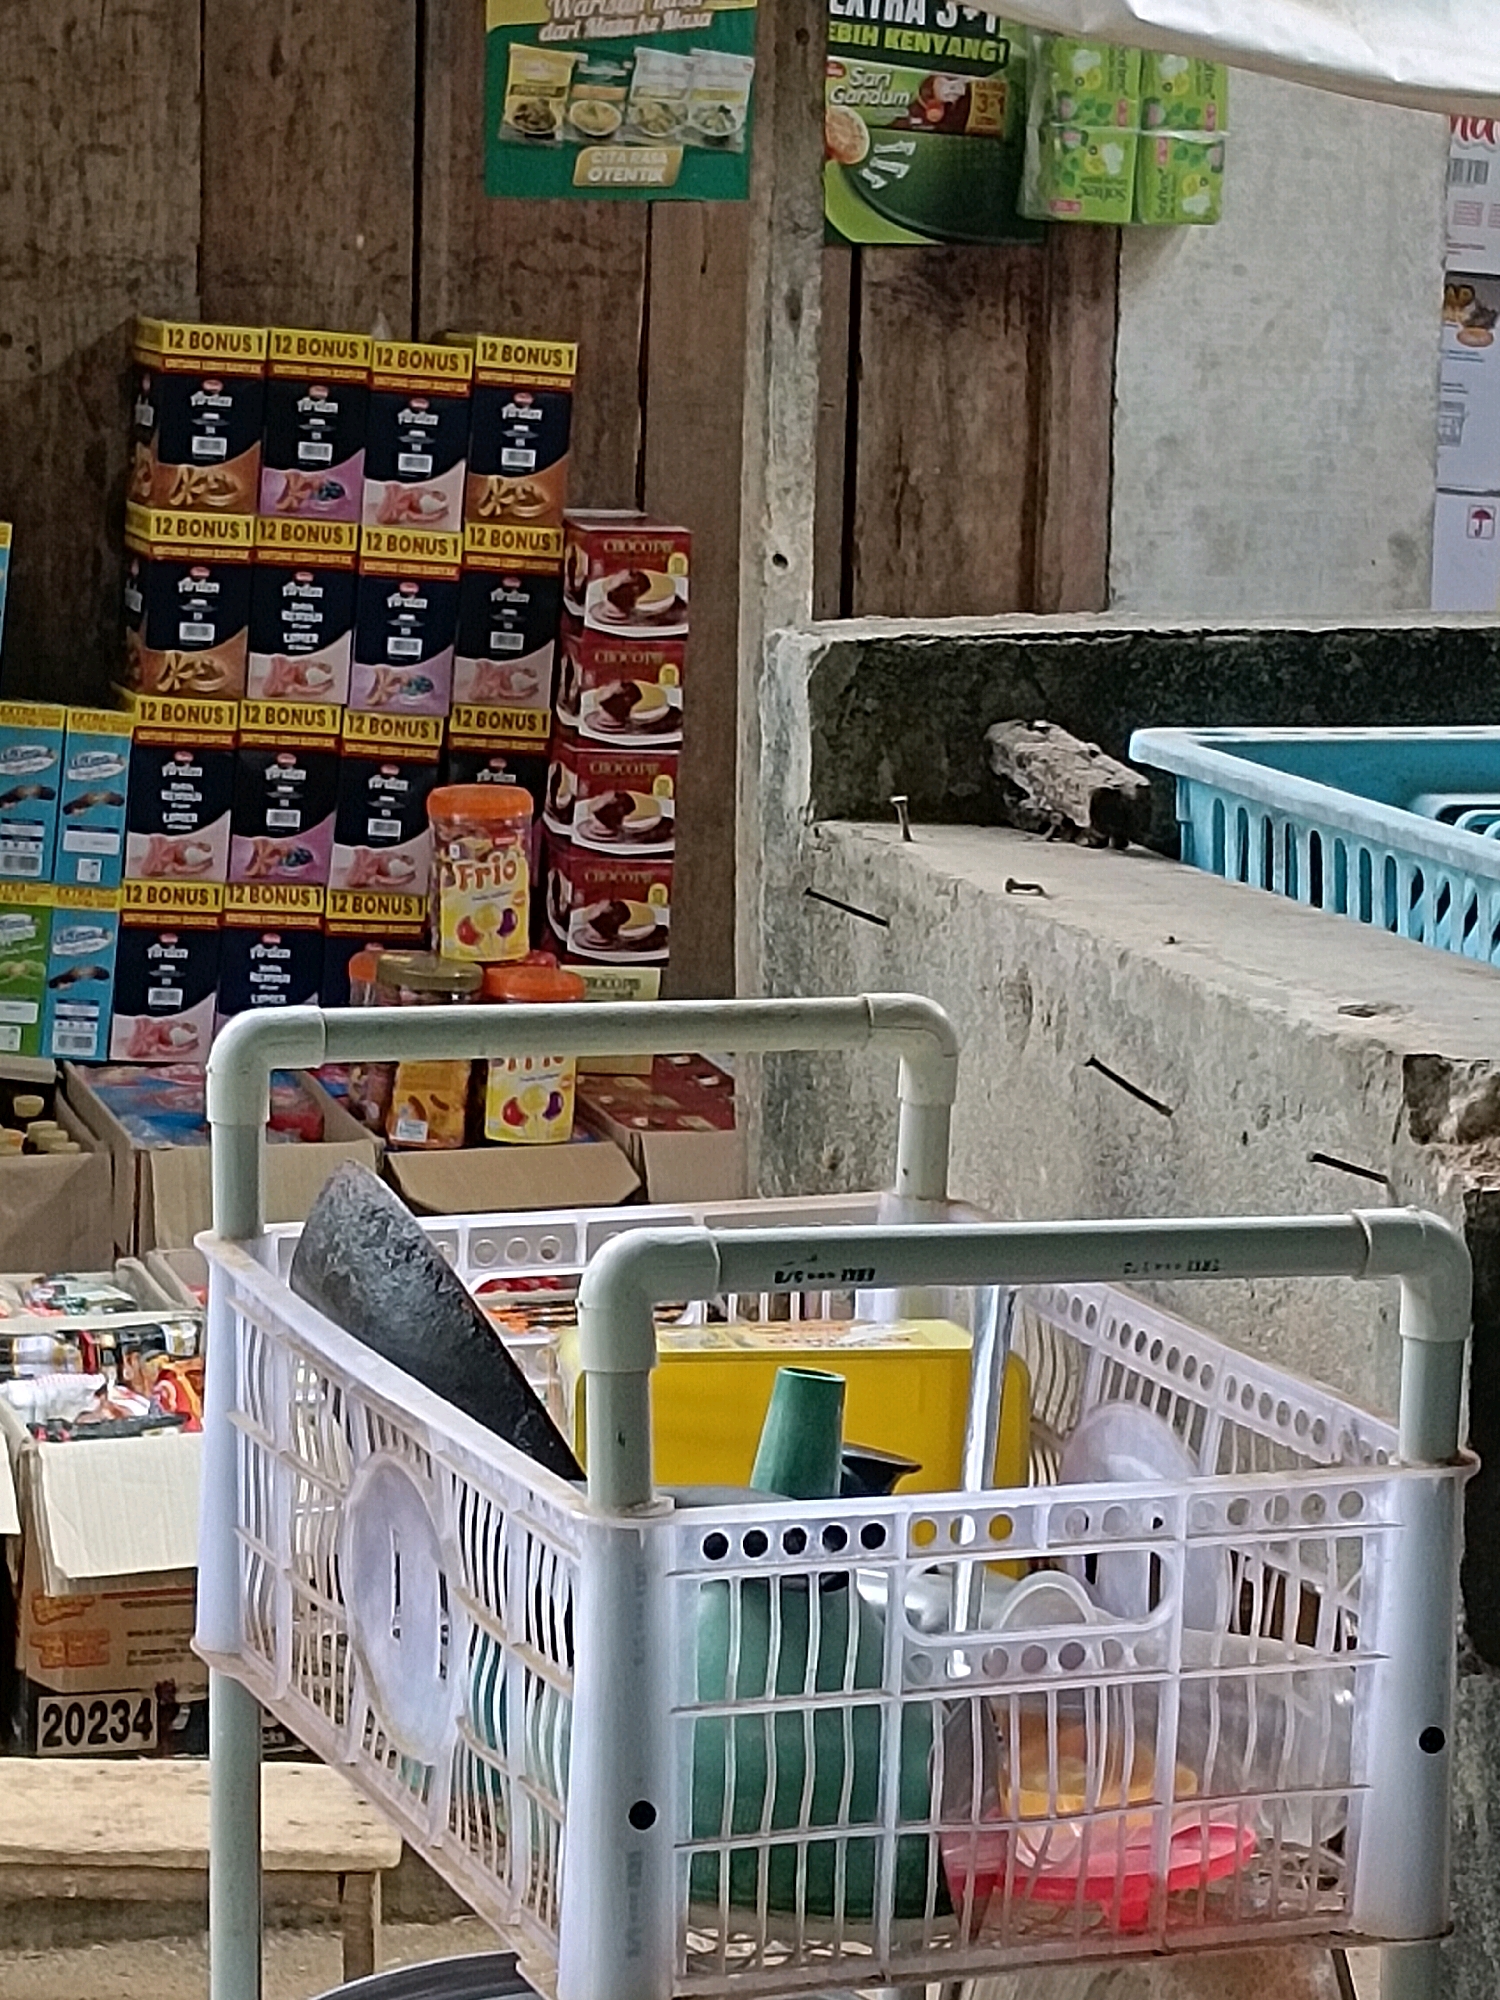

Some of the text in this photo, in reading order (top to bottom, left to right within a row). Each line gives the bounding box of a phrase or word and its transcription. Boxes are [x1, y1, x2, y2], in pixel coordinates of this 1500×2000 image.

[884, 27, 1006, 64] KENYANG!
[850, 67, 892, 89] Sari
[830, 85, 910, 106] Gandum
[587, 166, 664, 183] OTENTIK
[168, 329, 185, 349] 12
[190, 331, 252, 351] BONUS
[275, 335, 292, 354] 12
[297, 337, 359, 359] BONUS
[376, 347, 393, 367] 12
[399, 350, 459, 370] BONUS
[481, 342, 497, 361] 12
[502, 344, 563, 367] BONUS
[155, 517, 172, 536] 12
[177, 519, 240, 539] BONUS
[260, 522, 276, 541] 12
[281, 524, 343, 544] BONUS
[470, 526, 486, 546] 12
[491, 529, 551, 550] BONUS
[366, 532, 383, 551] 12
[387, 535, 448, 555] BONUS
[140, 702, 157, 721] 12
[161, 704, 224, 724] BONUS
[243, 705, 261, 724] 12
[265, 707, 326, 727] BONUS
[456, 709, 472, 727] 12
[477, 711, 536, 731] BONUS
[349, 715, 365, 733] 12
[369, 717, 429, 739] BONUS
[455, 855, 517, 893] Frio
[126, 885, 142, 903] 12
[147, 887, 208, 906] BONUS
[229, 886, 245, 904] 12
[250, 887, 310, 905] BONUS
[330, 894, 347, 913] 12
[352, 896, 412, 916] BONUS
[42, 1698, 154, 1748] 20234
